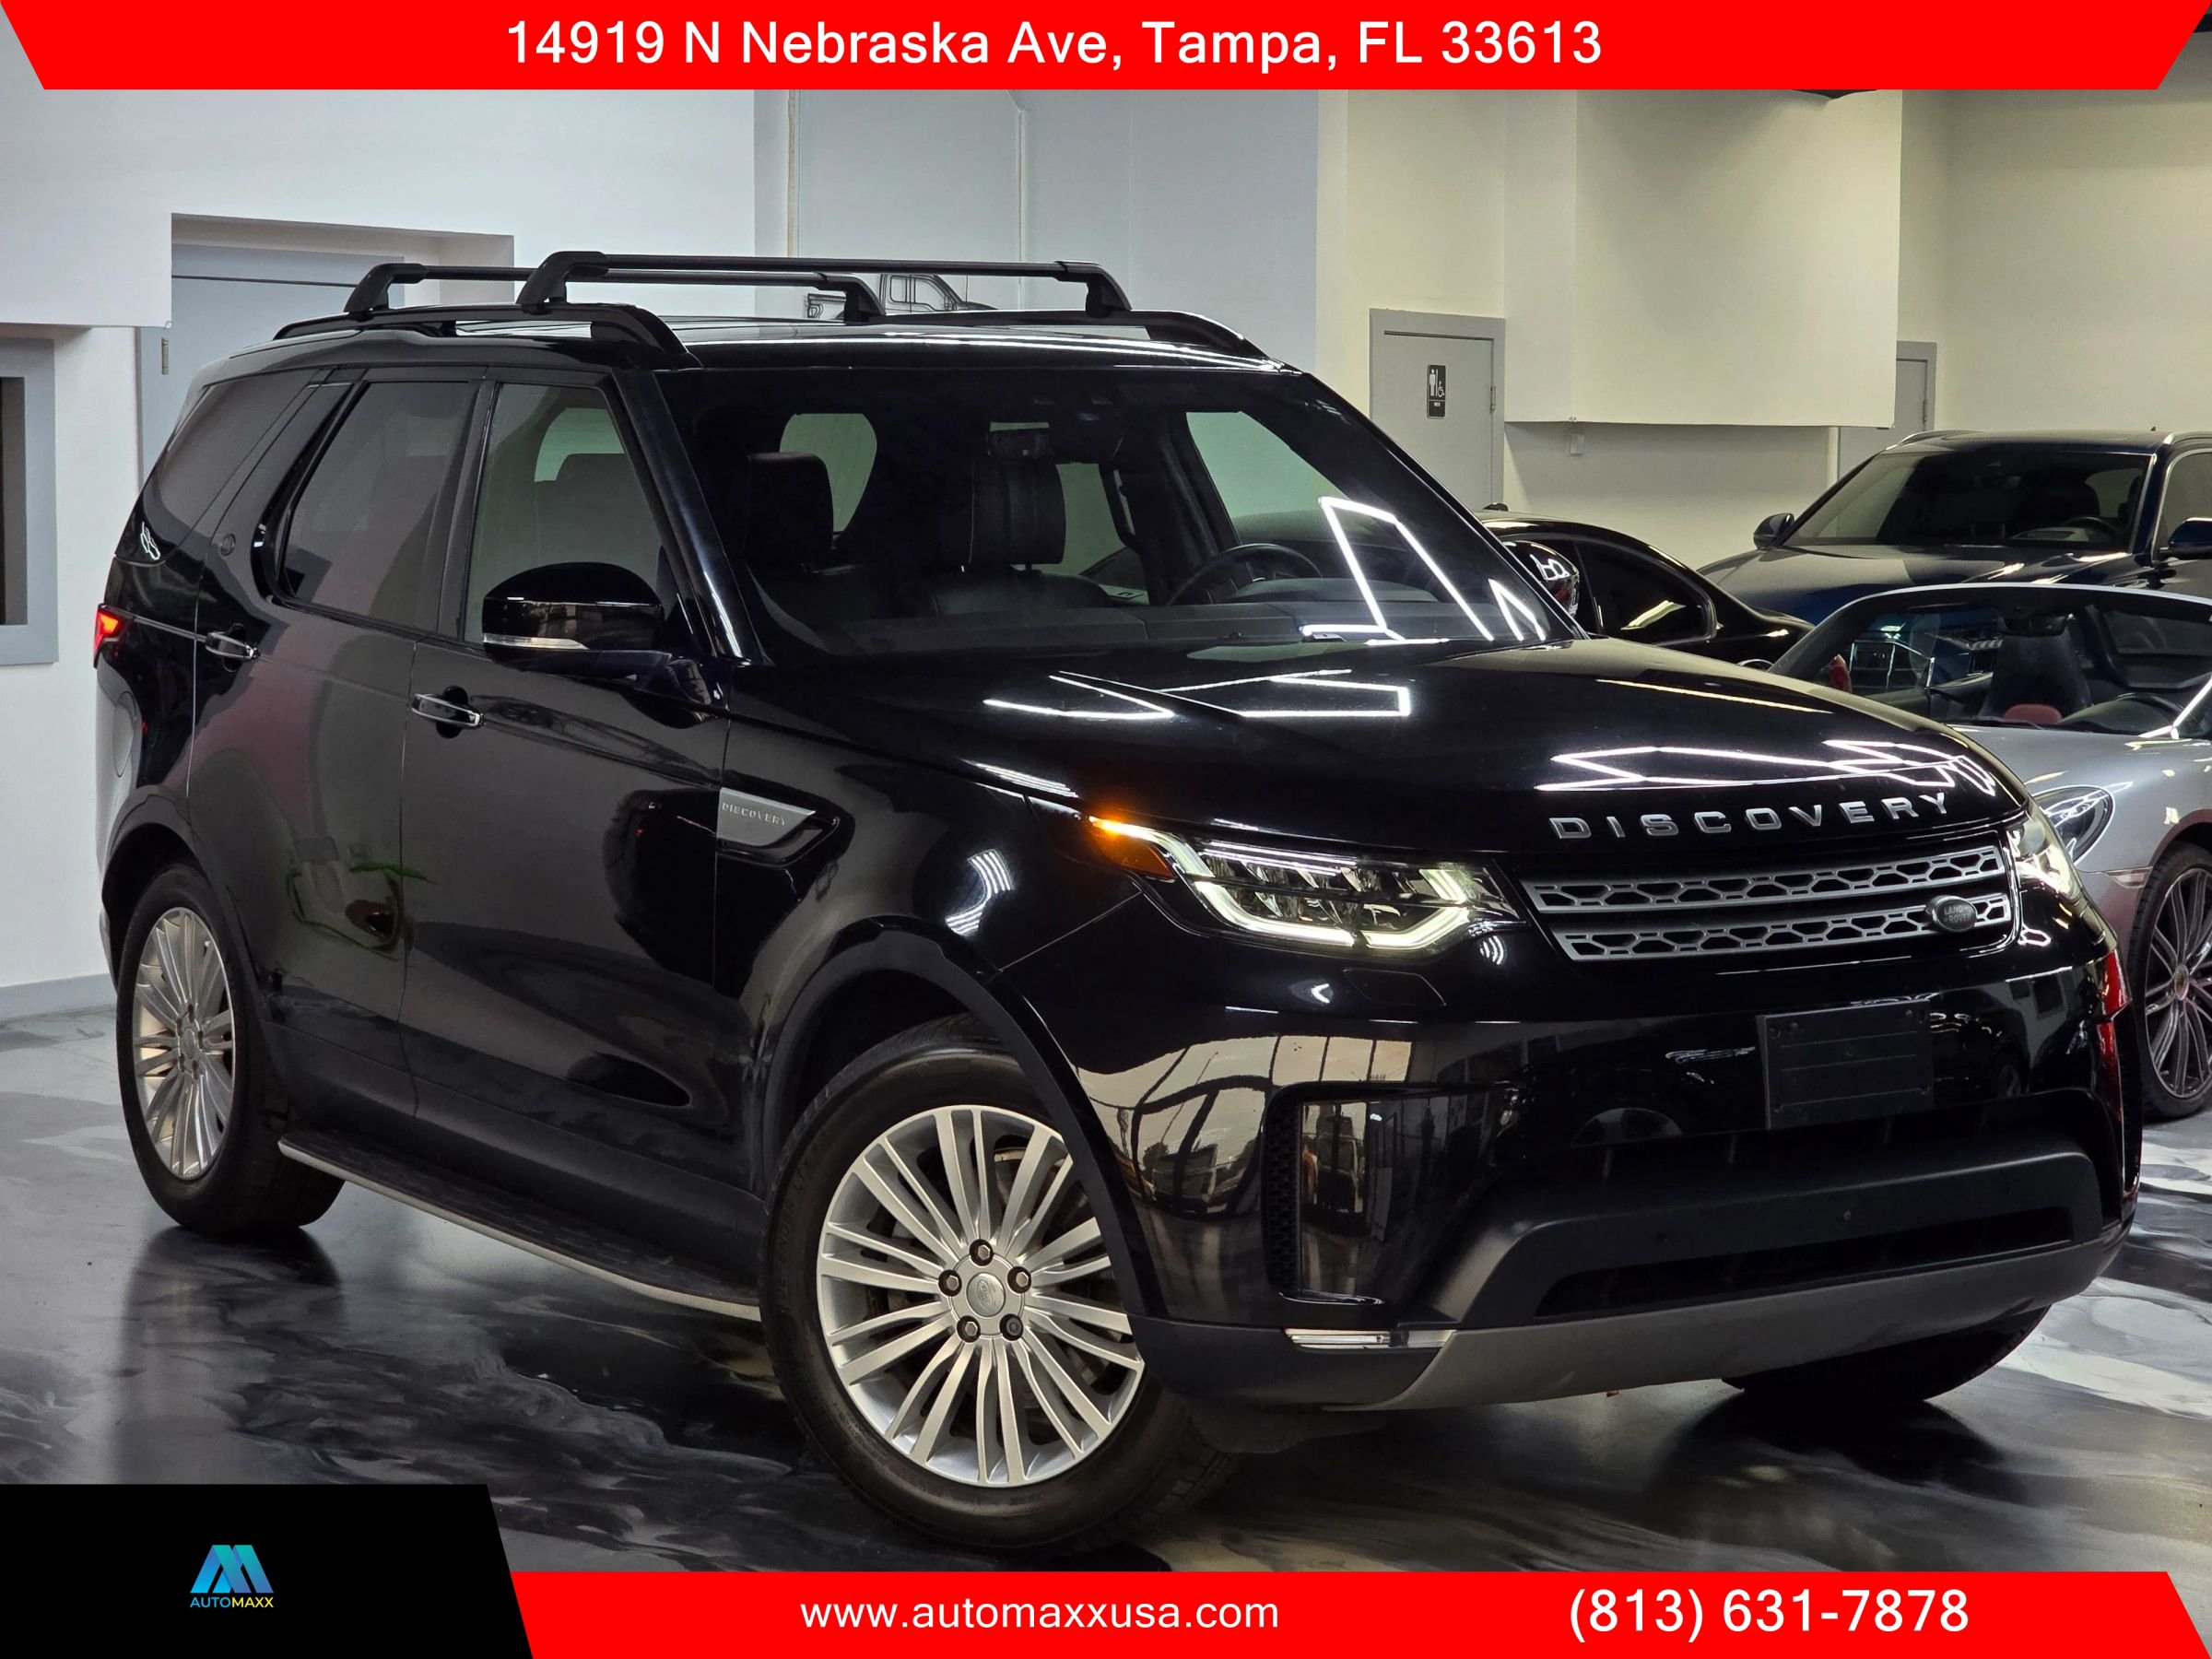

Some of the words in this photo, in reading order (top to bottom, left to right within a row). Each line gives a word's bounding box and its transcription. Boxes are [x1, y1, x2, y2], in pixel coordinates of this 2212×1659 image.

[722, 801, 786, 827] DISCOVERY
[1548, 792, 1950, 840] DISCOVERY
[1944, 905, 1964, 915] LAND
